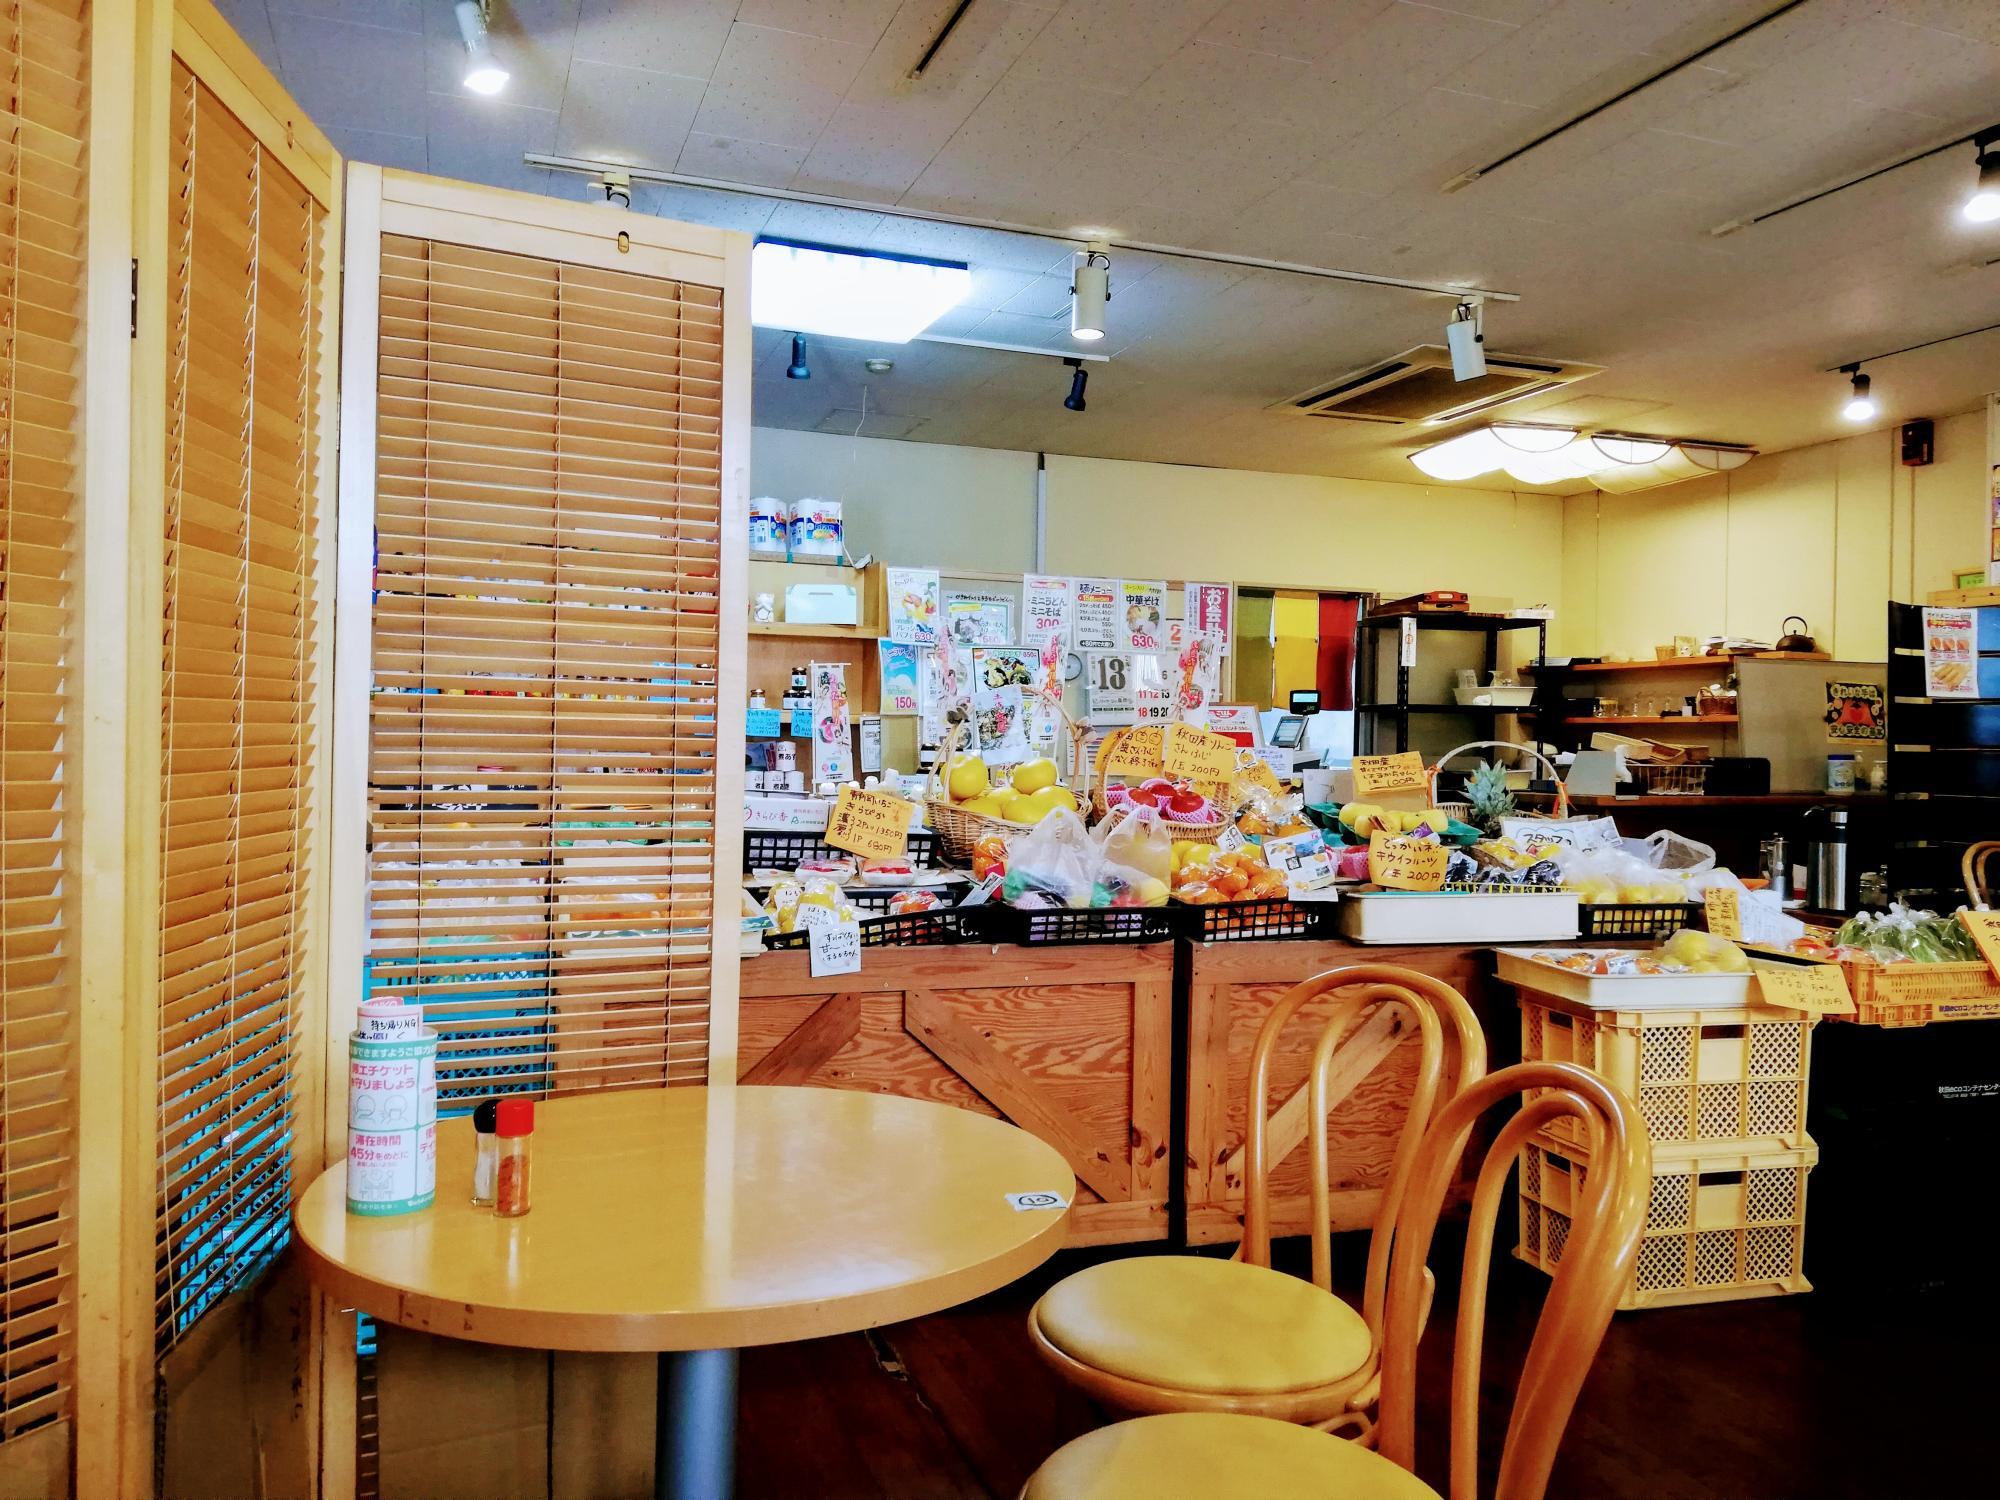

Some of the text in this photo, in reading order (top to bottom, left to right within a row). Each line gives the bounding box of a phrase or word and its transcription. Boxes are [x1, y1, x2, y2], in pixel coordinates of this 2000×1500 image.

[1125, 595, 1160, 606] 中華そば
[1098, 658, 1126, 690] 13
[1138, 707, 1147, 717] 18
[1150, 707, 1159, 717] 19
[1176, 727, 1208, 746] 秋田産
[1191, 764, 1220, 777] 200円
[1376, 851, 1438, 867] キウイフルーツ
[1407, 871, 1441, 882] 200円
[355, 1134, 401, 1147] 滞在時間
